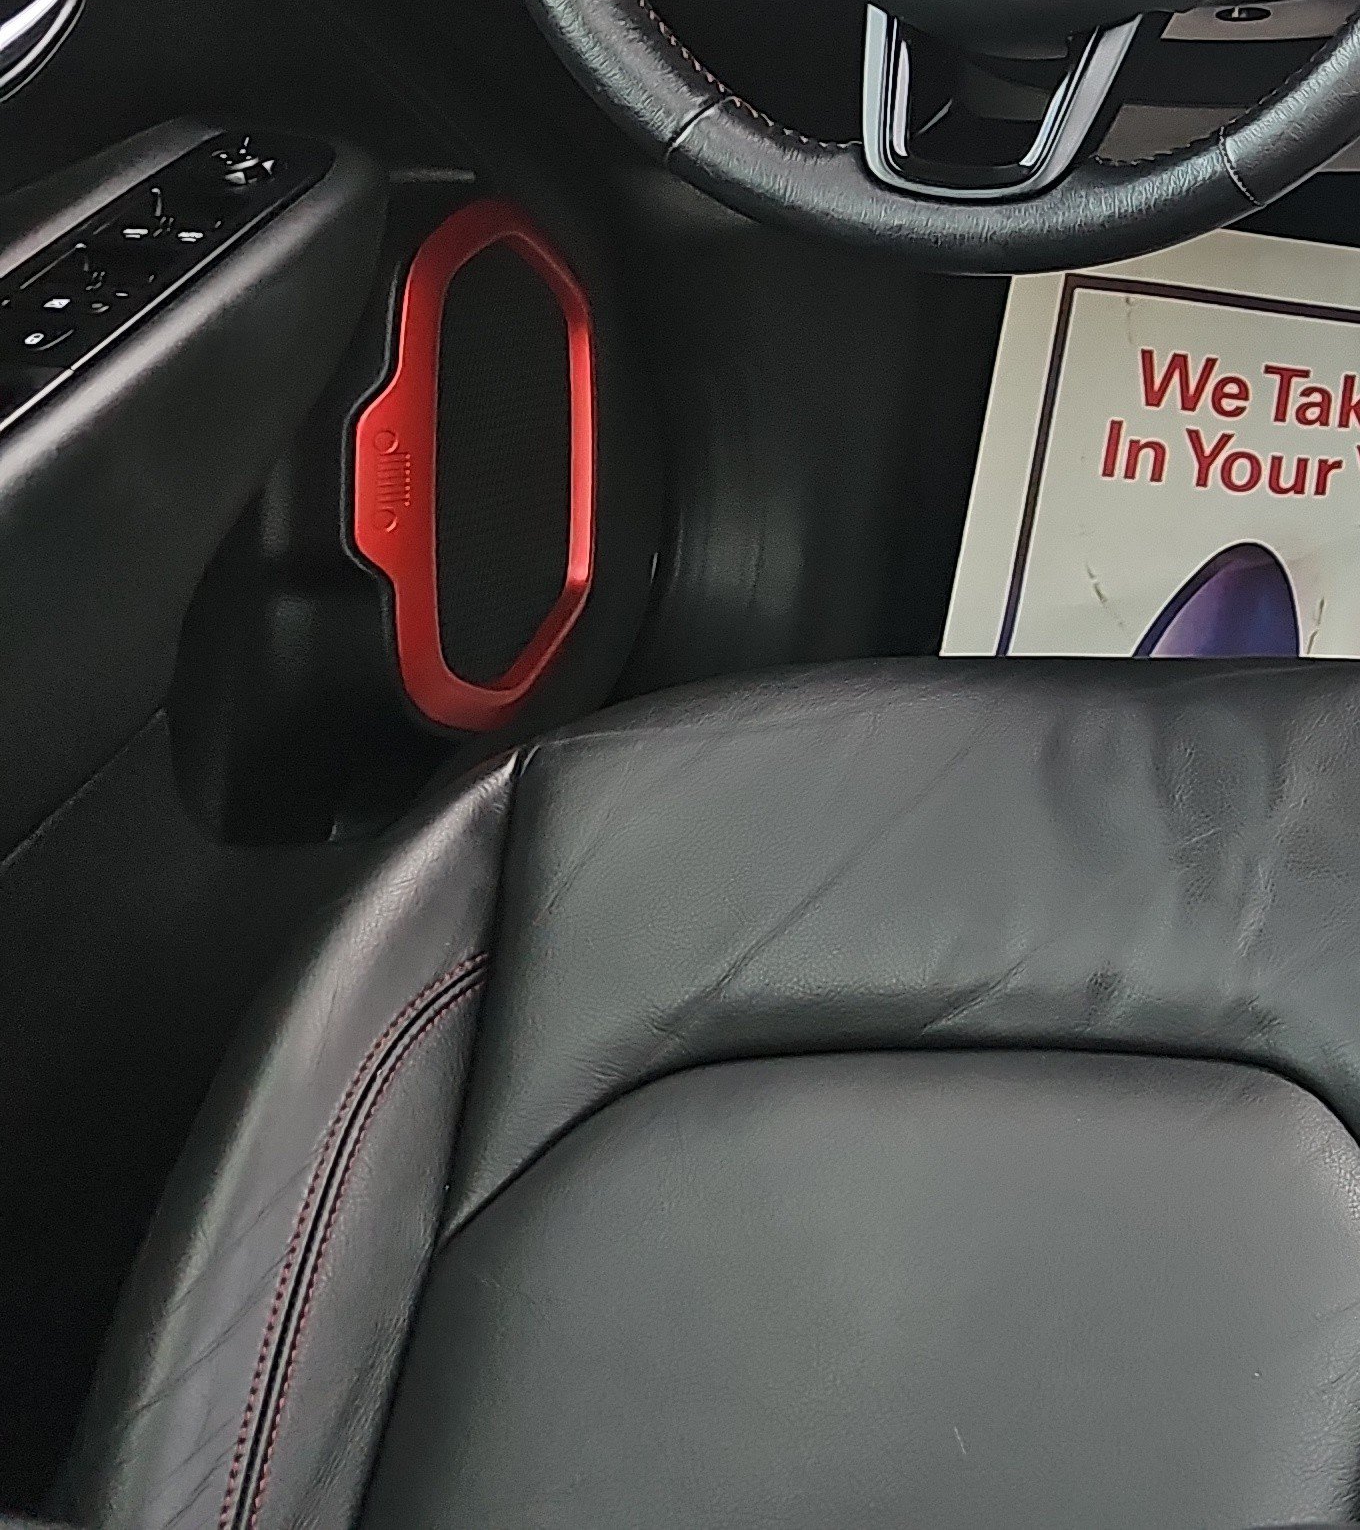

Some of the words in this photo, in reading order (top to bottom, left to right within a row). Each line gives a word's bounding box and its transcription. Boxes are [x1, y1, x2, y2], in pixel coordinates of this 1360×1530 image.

[1140, 348, 1252, 417] We
[1101, 418, 1168, 484] In
[1185, 427, 1344, 497] Your
